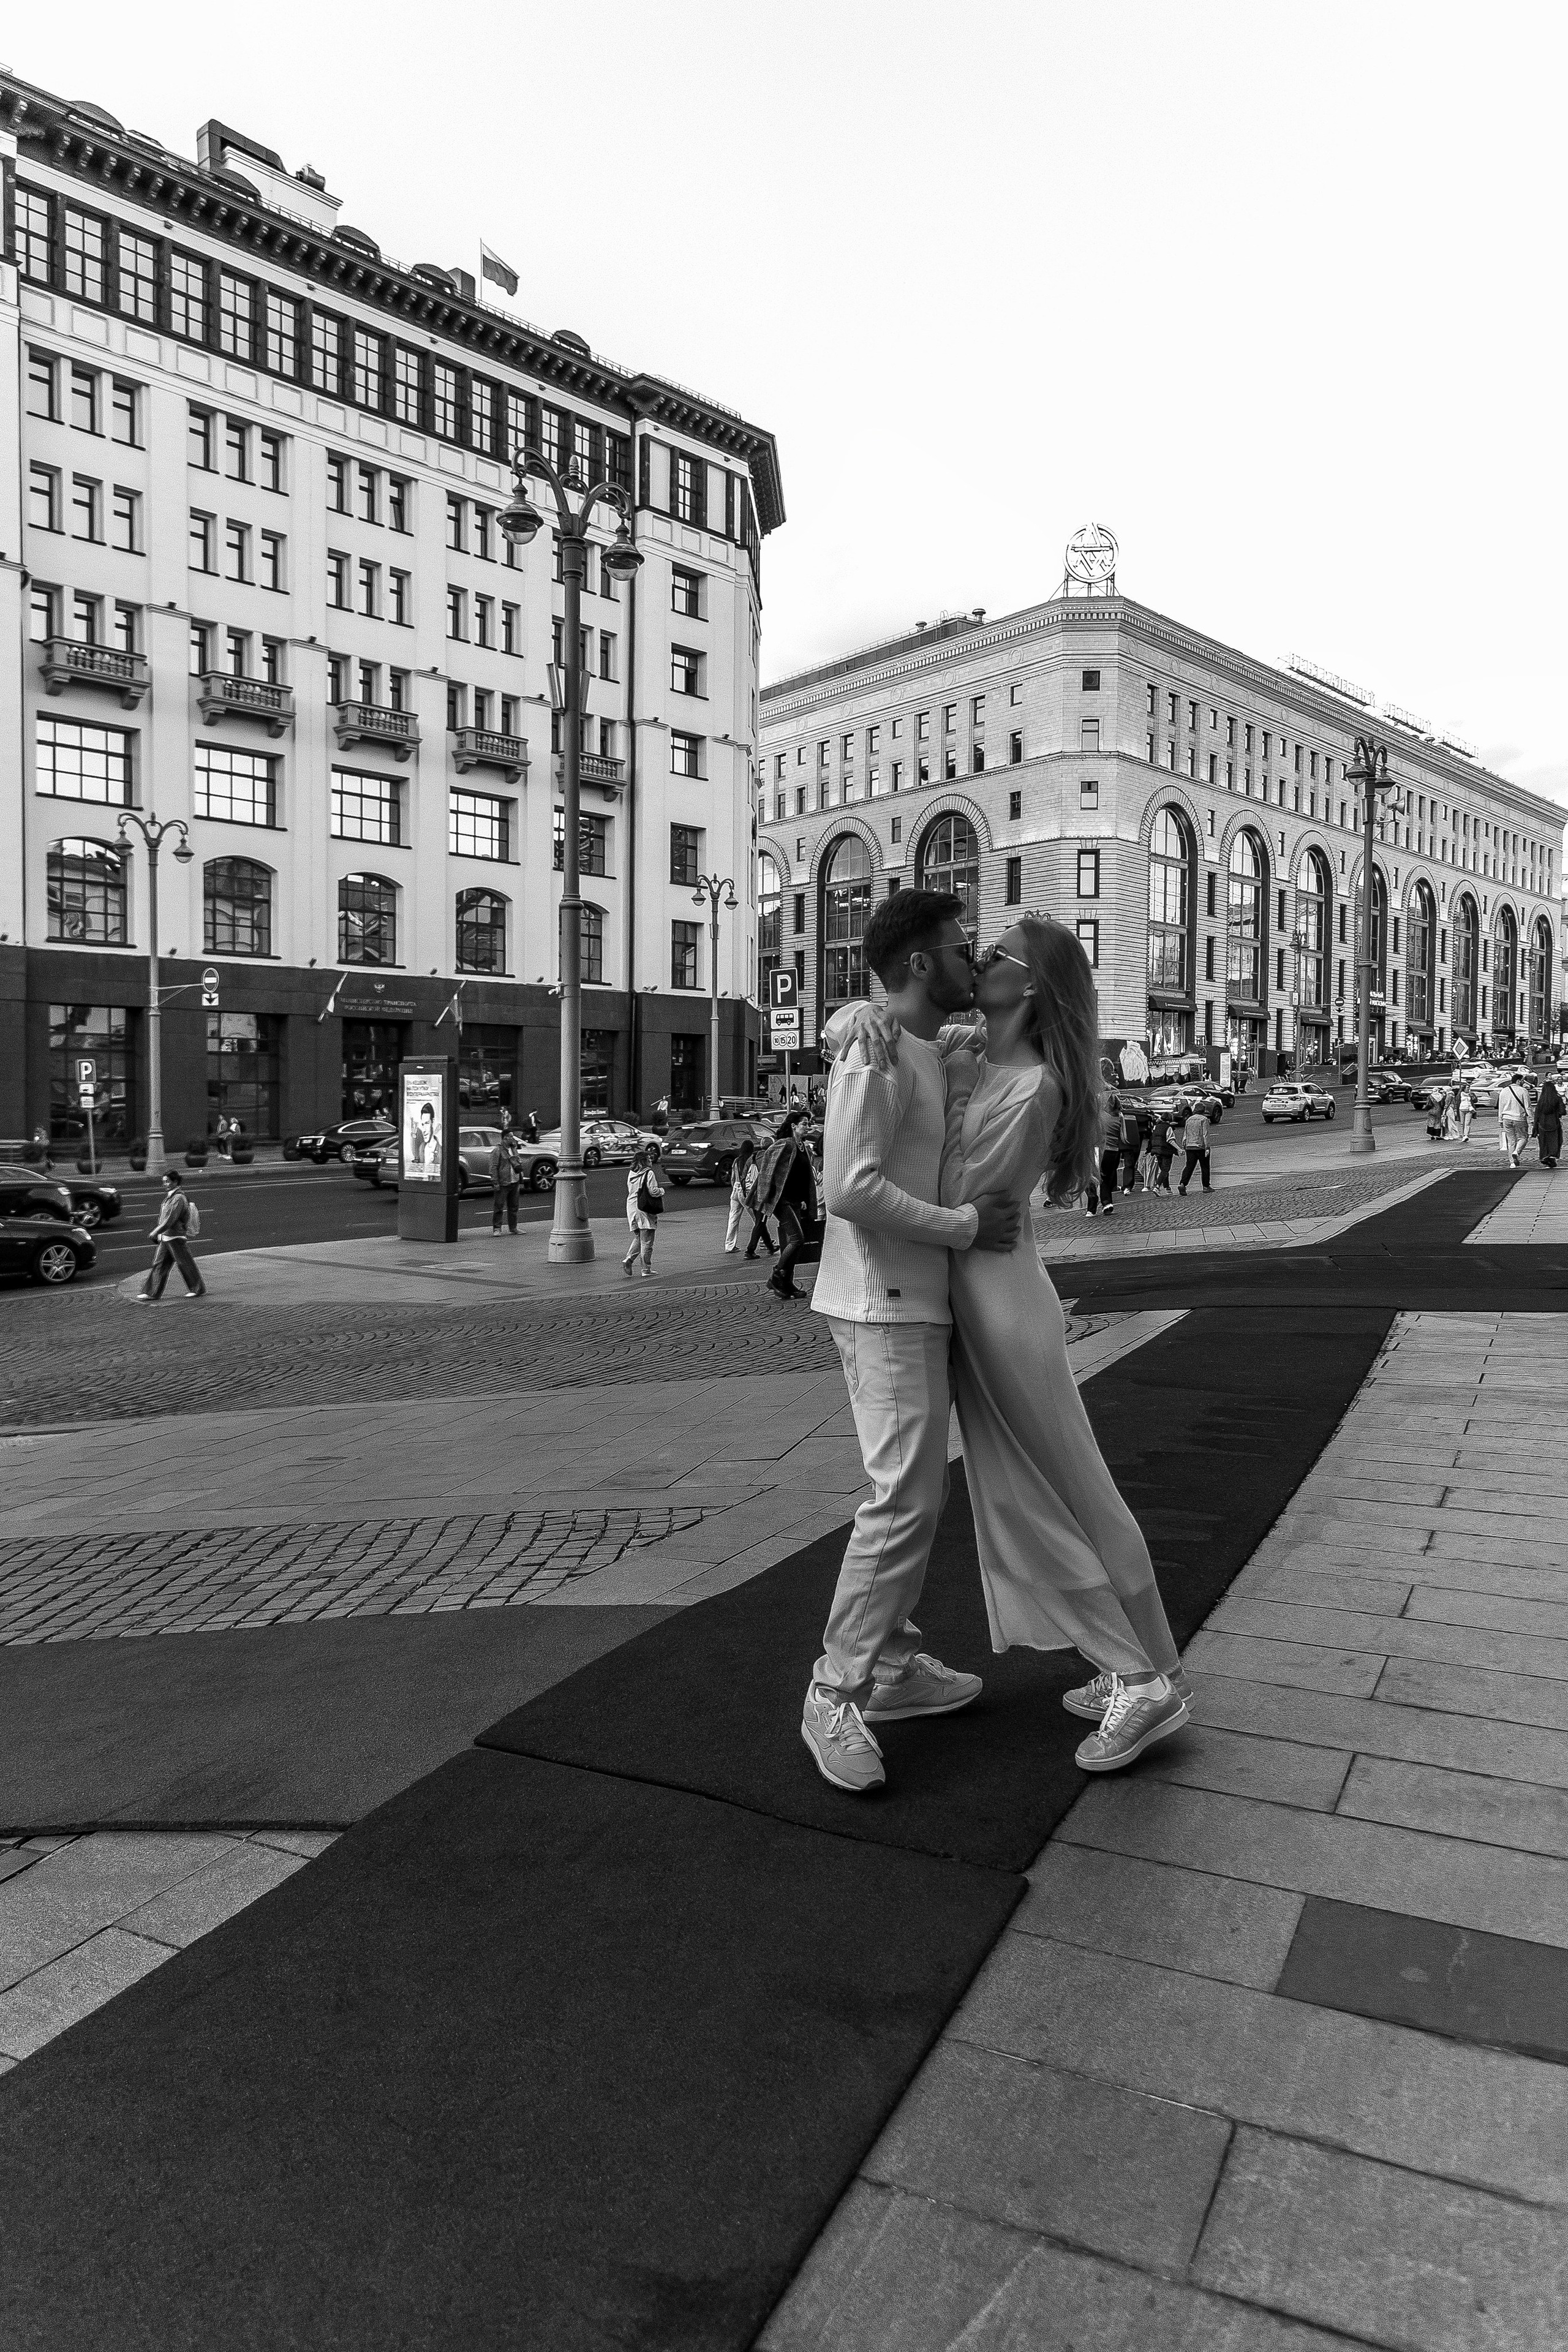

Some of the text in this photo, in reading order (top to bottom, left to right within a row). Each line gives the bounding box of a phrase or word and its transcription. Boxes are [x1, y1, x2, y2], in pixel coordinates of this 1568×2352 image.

[777, 974, 792, 1003] P
[787, 1036, 796, 1044] 20
[80, 1061, 92, 1080] P
